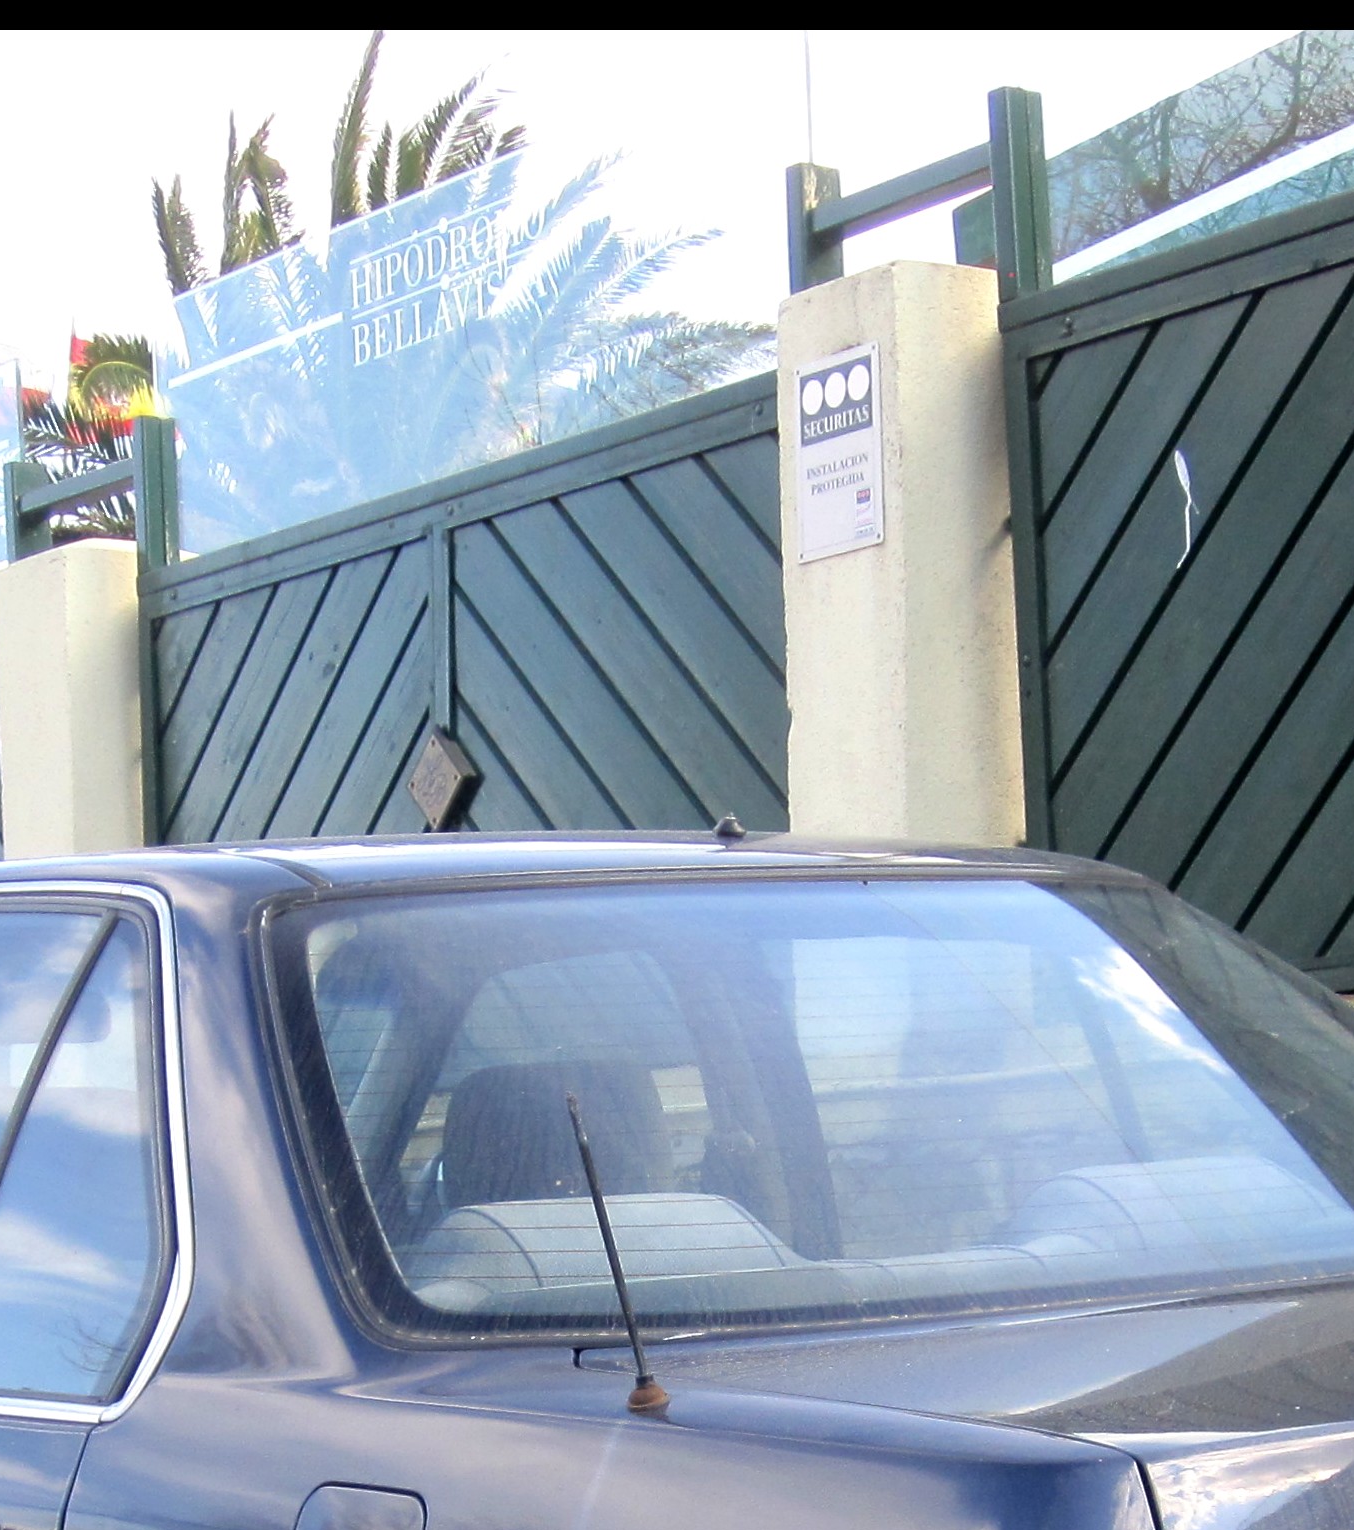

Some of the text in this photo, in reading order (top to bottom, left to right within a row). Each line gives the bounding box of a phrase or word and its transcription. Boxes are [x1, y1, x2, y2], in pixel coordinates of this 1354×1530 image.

[351, 262, 548, 367] BELLAVIS
[803, 403, 870, 440] SECURITAS
[806, 452, 869, 480] INSTALACION
[810, 471, 864, 496] PROTEGIDA
